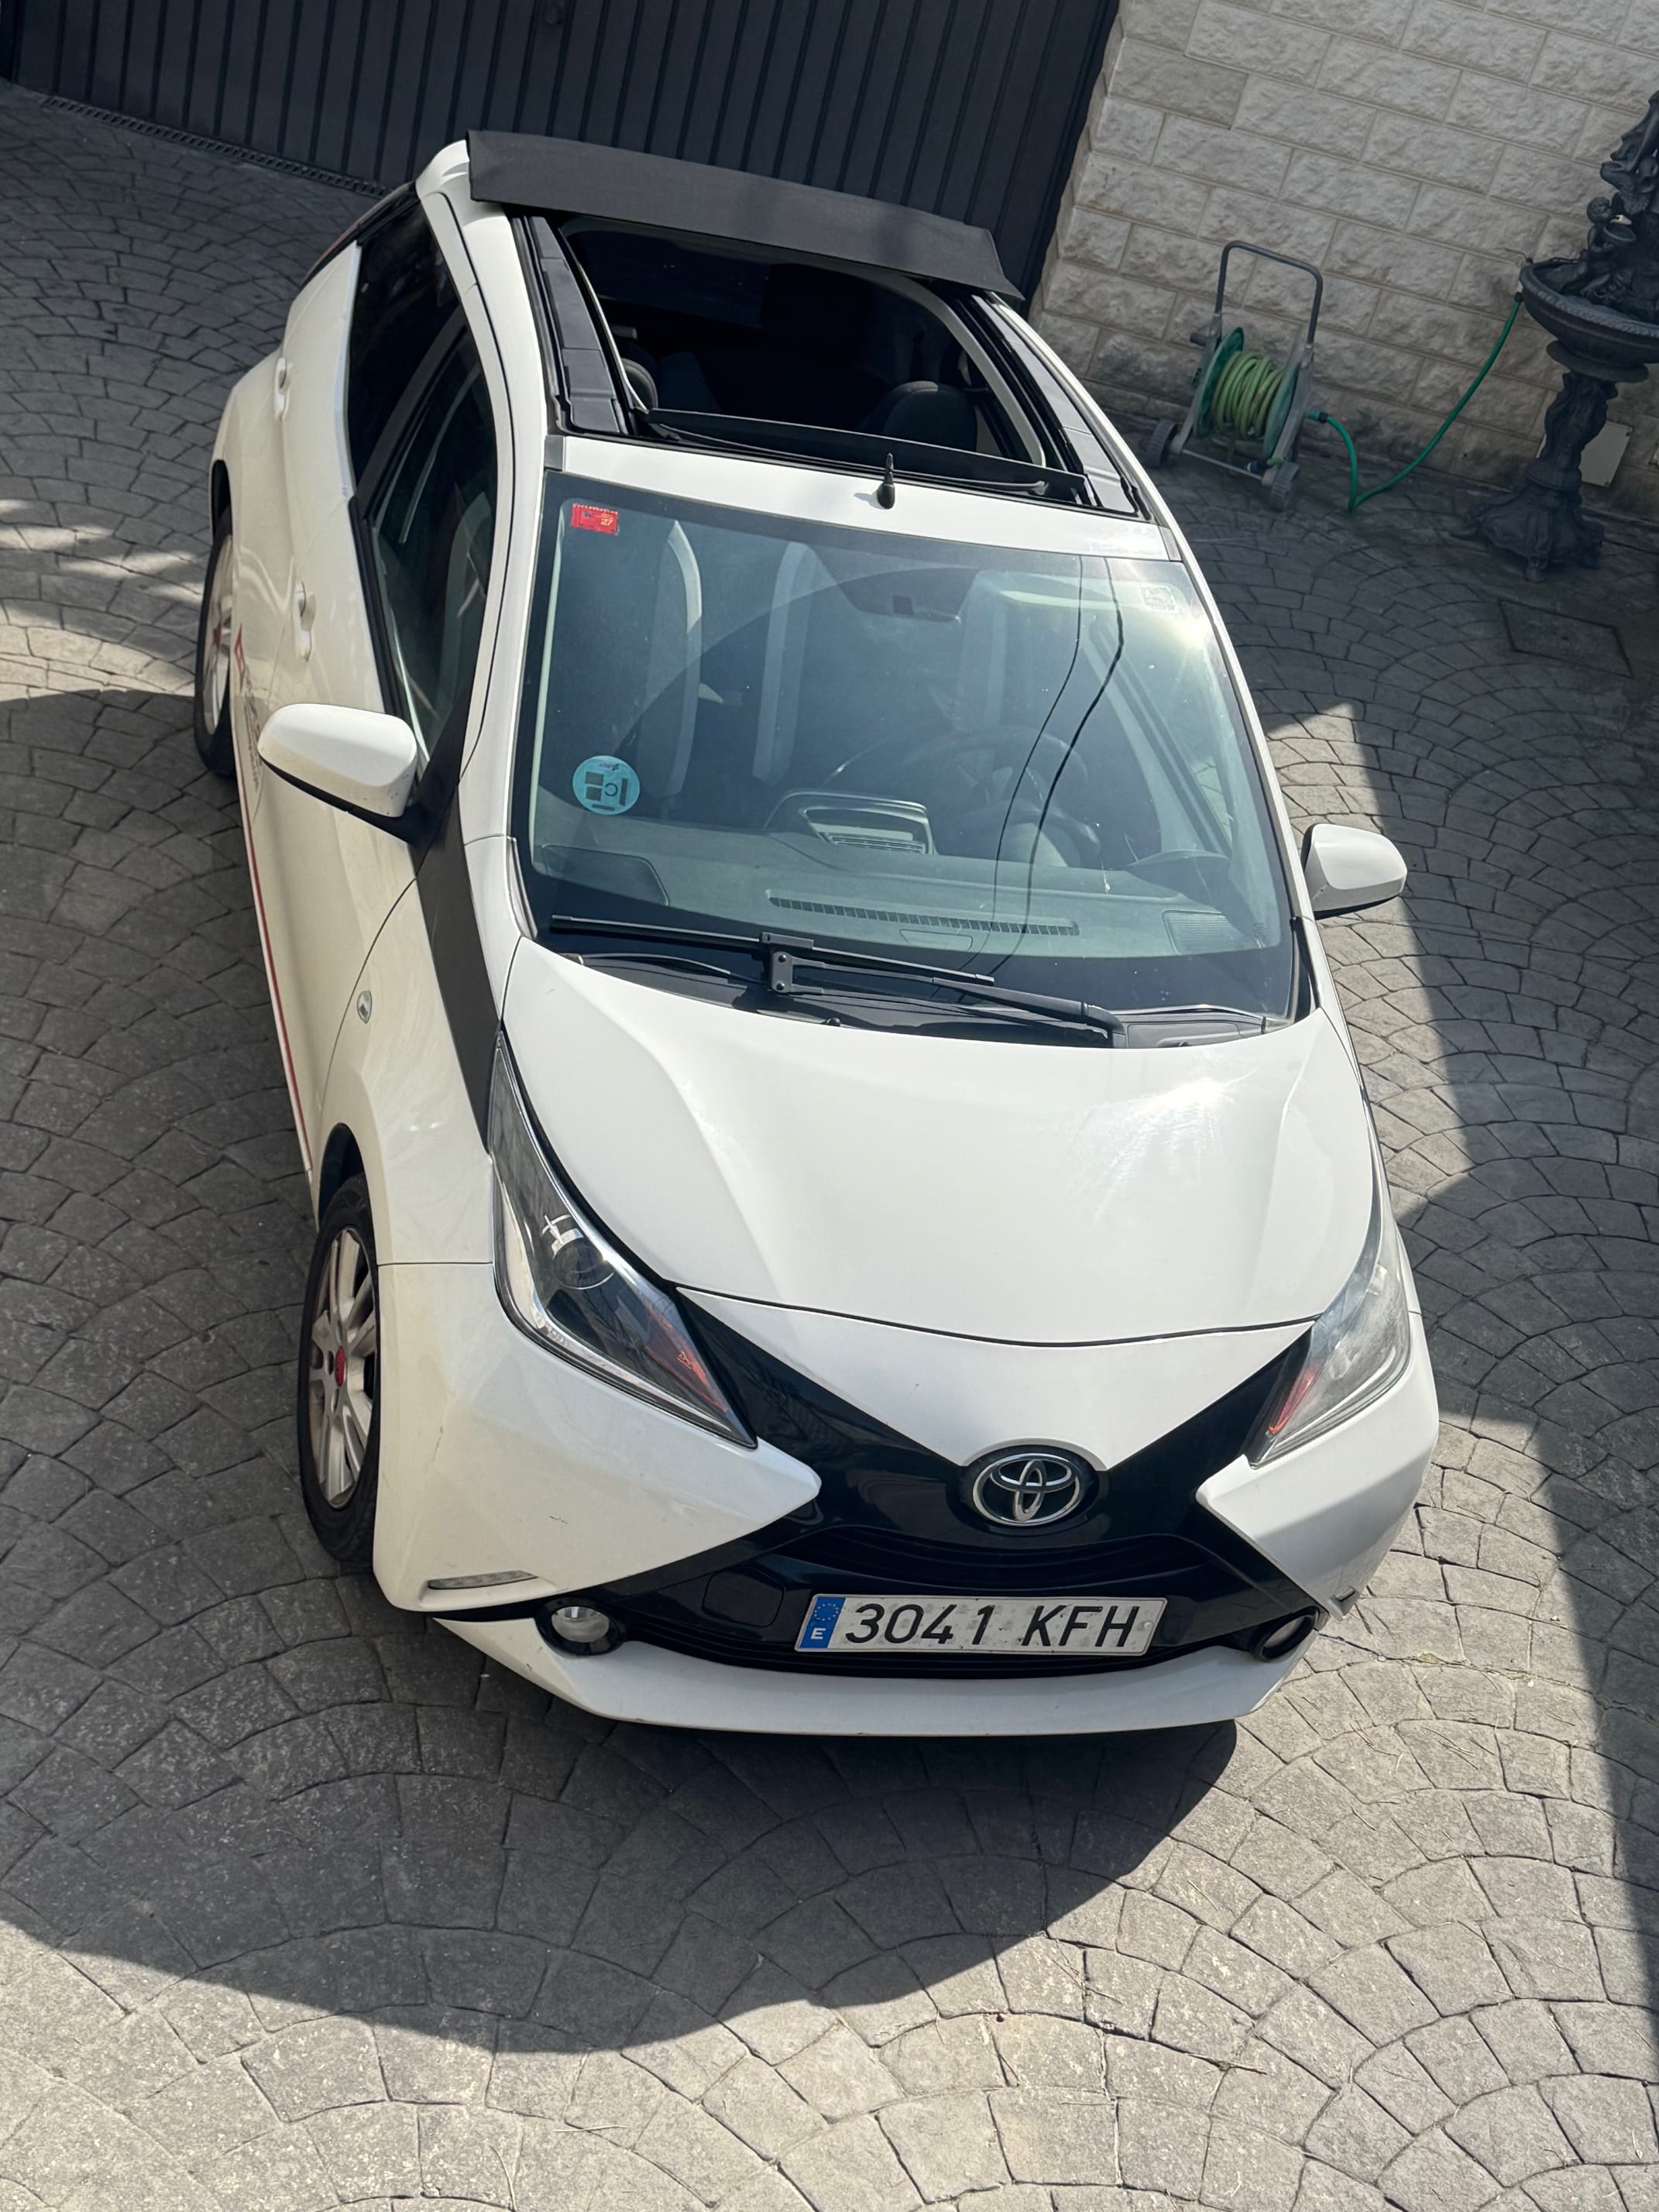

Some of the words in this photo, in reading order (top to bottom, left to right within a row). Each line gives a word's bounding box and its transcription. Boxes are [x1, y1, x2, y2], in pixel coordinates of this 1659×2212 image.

[810, 1627, 826, 1640] E
[846, 1603, 996, 1645] 3041
[1022, 1605, 1140, 1647] KFH
